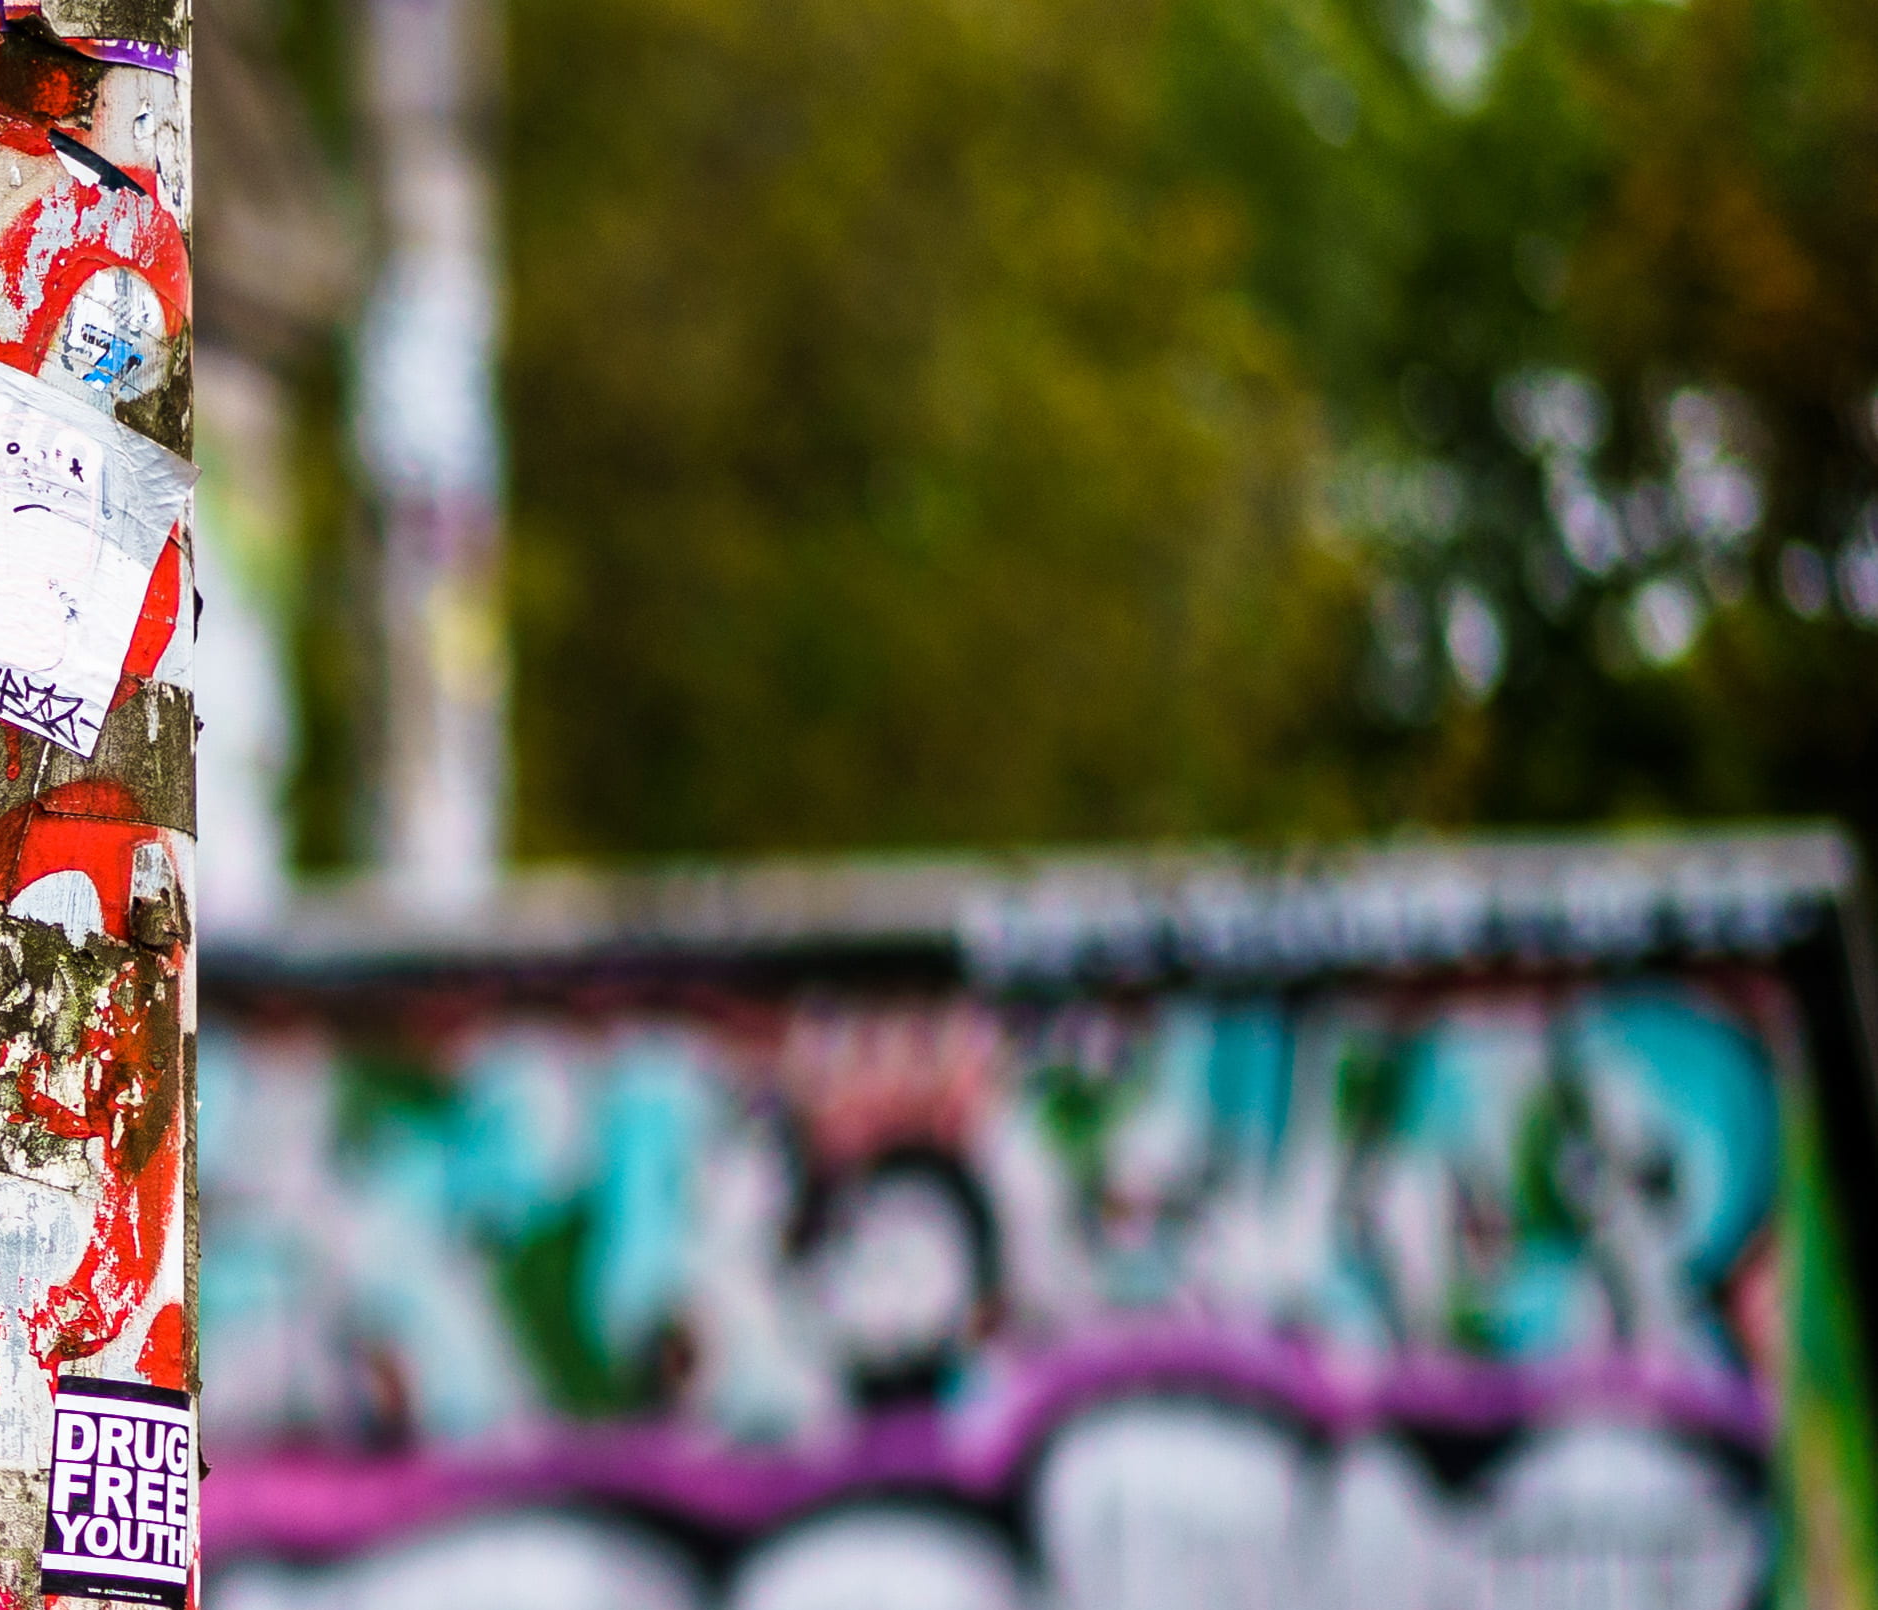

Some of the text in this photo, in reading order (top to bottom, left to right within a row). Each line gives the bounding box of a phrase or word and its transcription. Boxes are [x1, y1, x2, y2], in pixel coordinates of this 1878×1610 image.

[55, 1412, 188, 1475] DRUG
[52, 1462, 187, 1527] FREE
[52, 1513, 186, 1567] YOUTH
